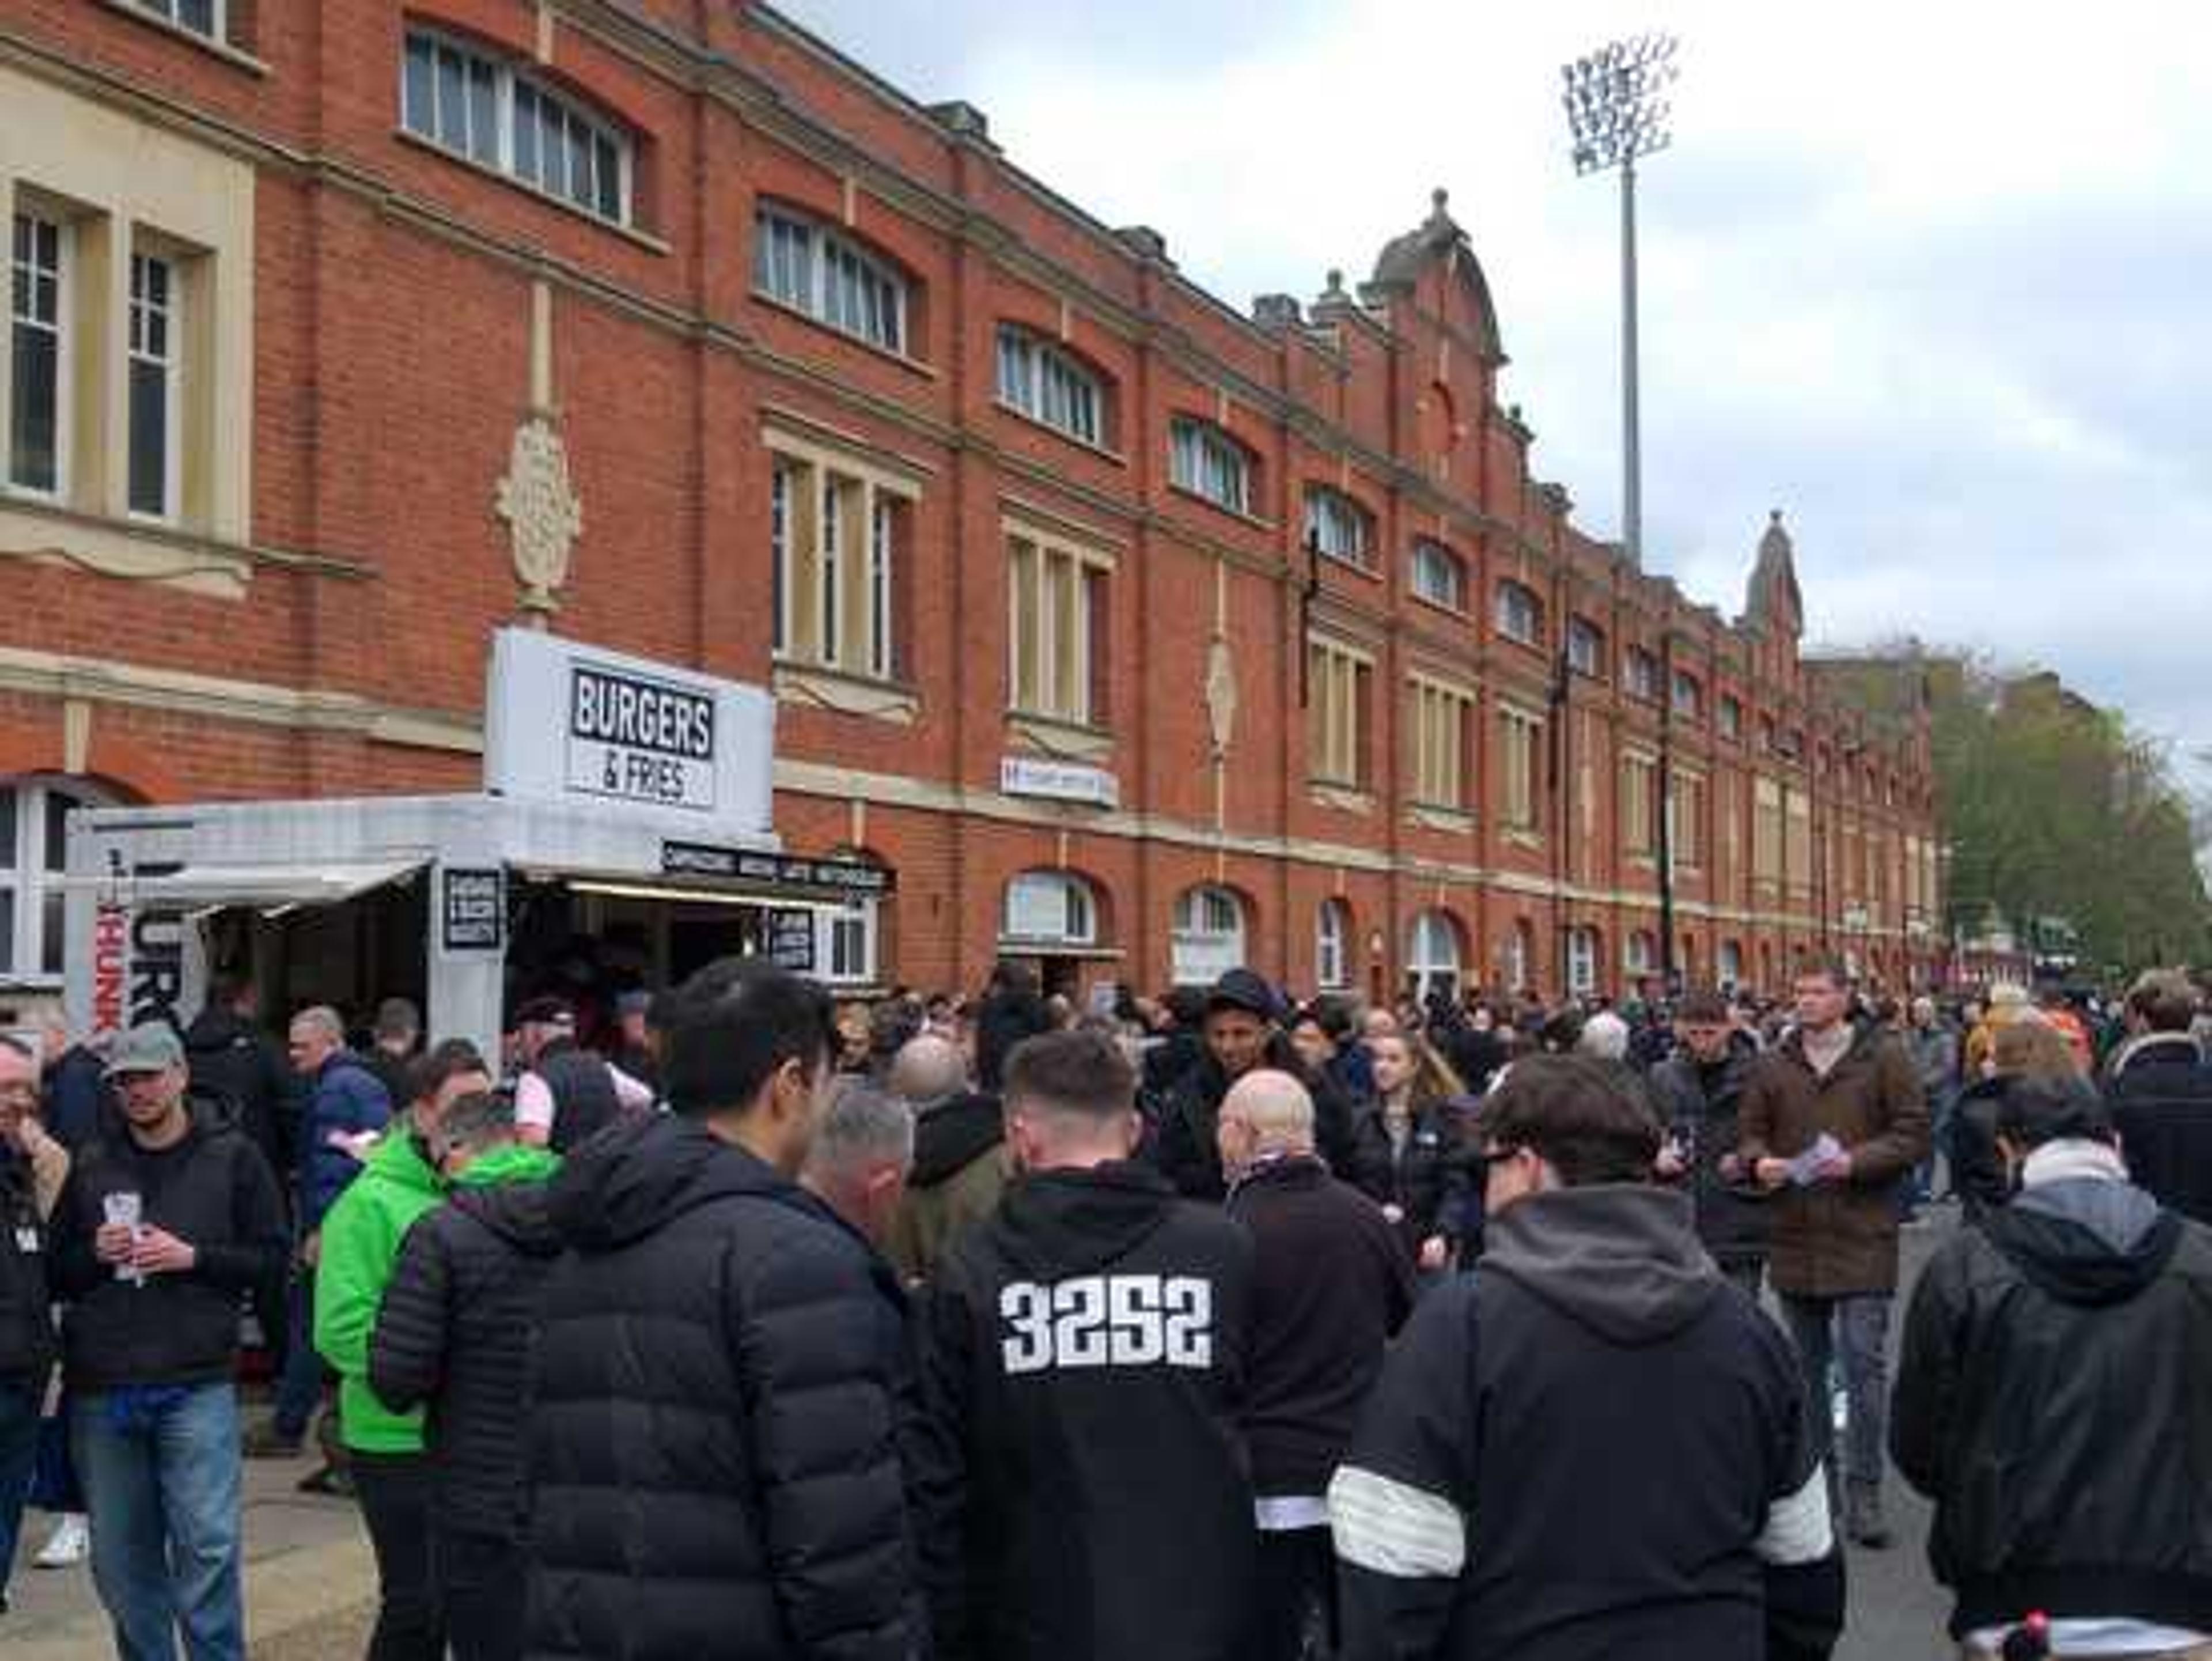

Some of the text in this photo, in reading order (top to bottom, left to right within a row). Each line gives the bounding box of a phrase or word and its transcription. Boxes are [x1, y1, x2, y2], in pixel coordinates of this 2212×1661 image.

[578, 675, 710, 754] BURGERS
[604, 748, 684, 797] & FRIES
[999, 1274, 1211, 1373] 3252
